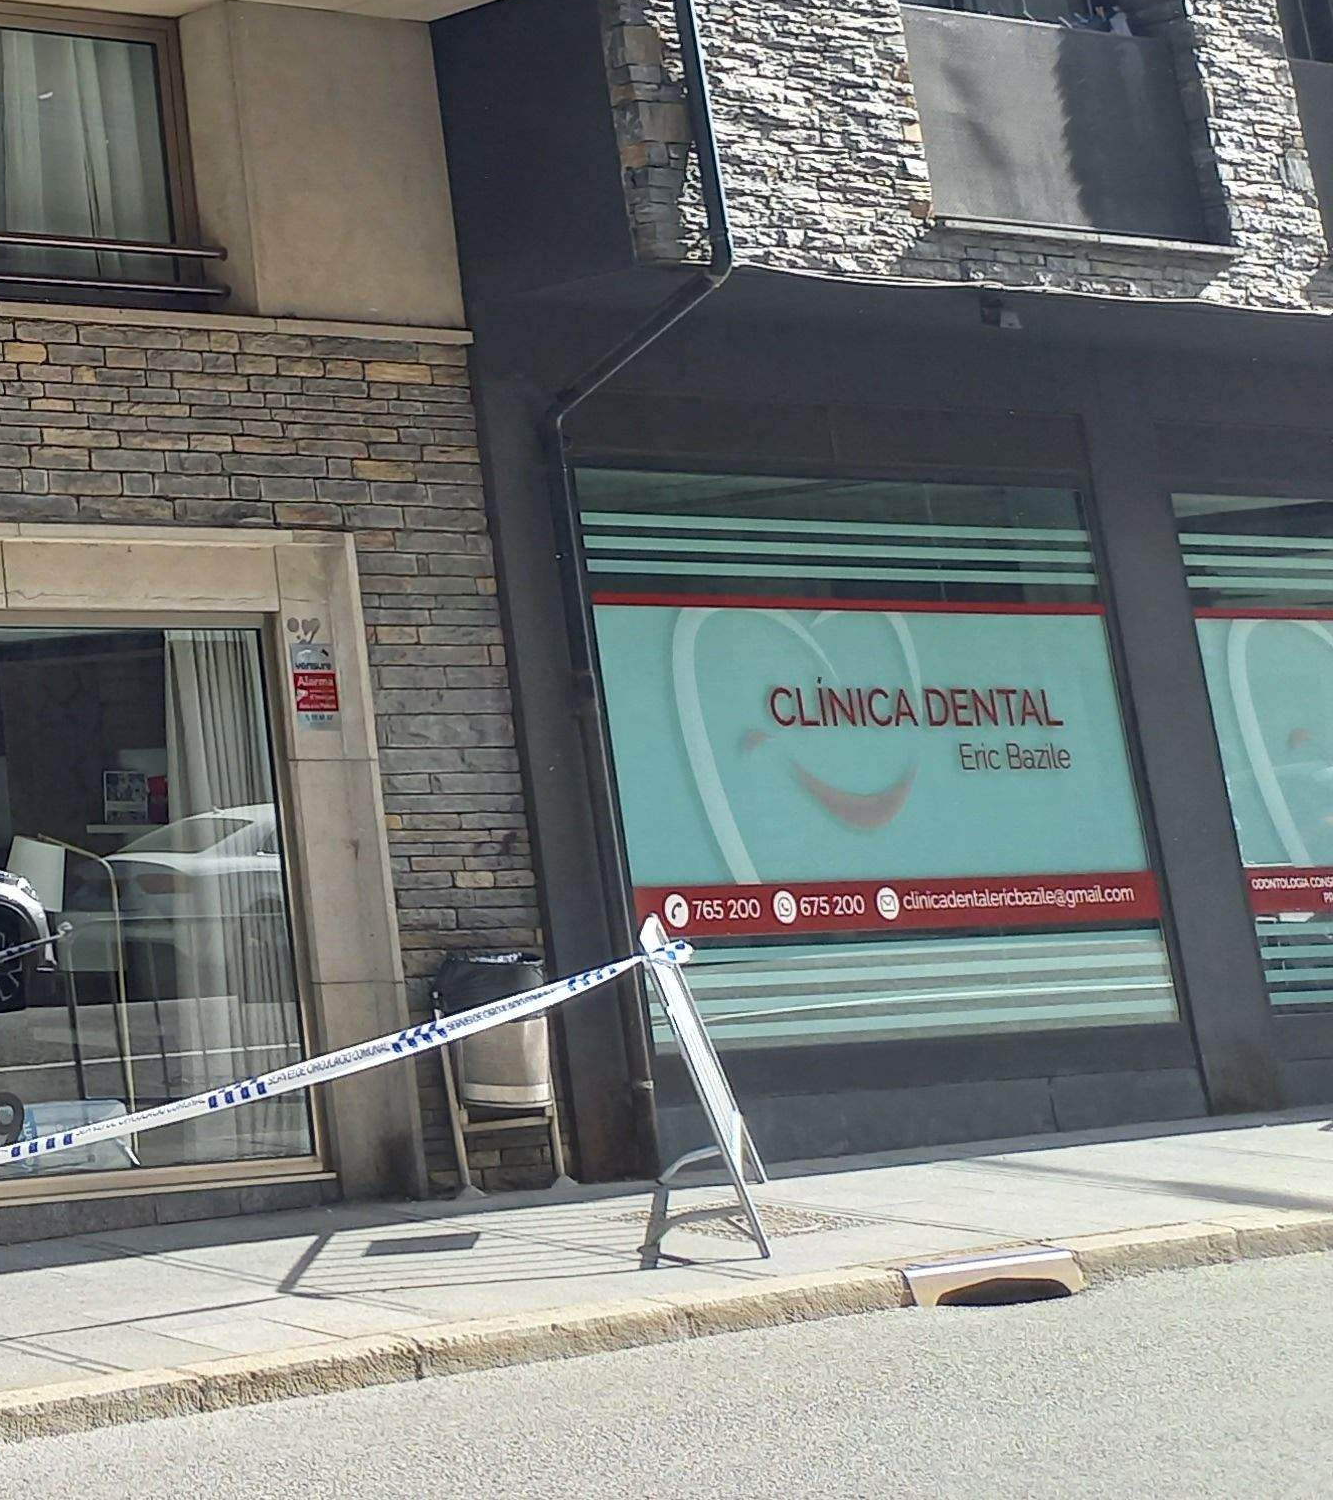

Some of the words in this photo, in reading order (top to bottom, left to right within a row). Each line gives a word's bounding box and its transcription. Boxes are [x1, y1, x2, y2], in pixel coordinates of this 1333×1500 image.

[770, 677, 919, 728] CLÍNICA
[922, 687, 1065, 728] DENTAL
[959, 743, 1001, 770] Eric
[1006, 742, 1071, 770] Bazile
[692, 900, 724, 920] 765
[727, 898, 761, 919] 200
[800, 896, 831, 916] 675
[833, 894, 865, 915] 200
[903, 884, 1135, 911] clinicadentalericbazile@gmail.com
